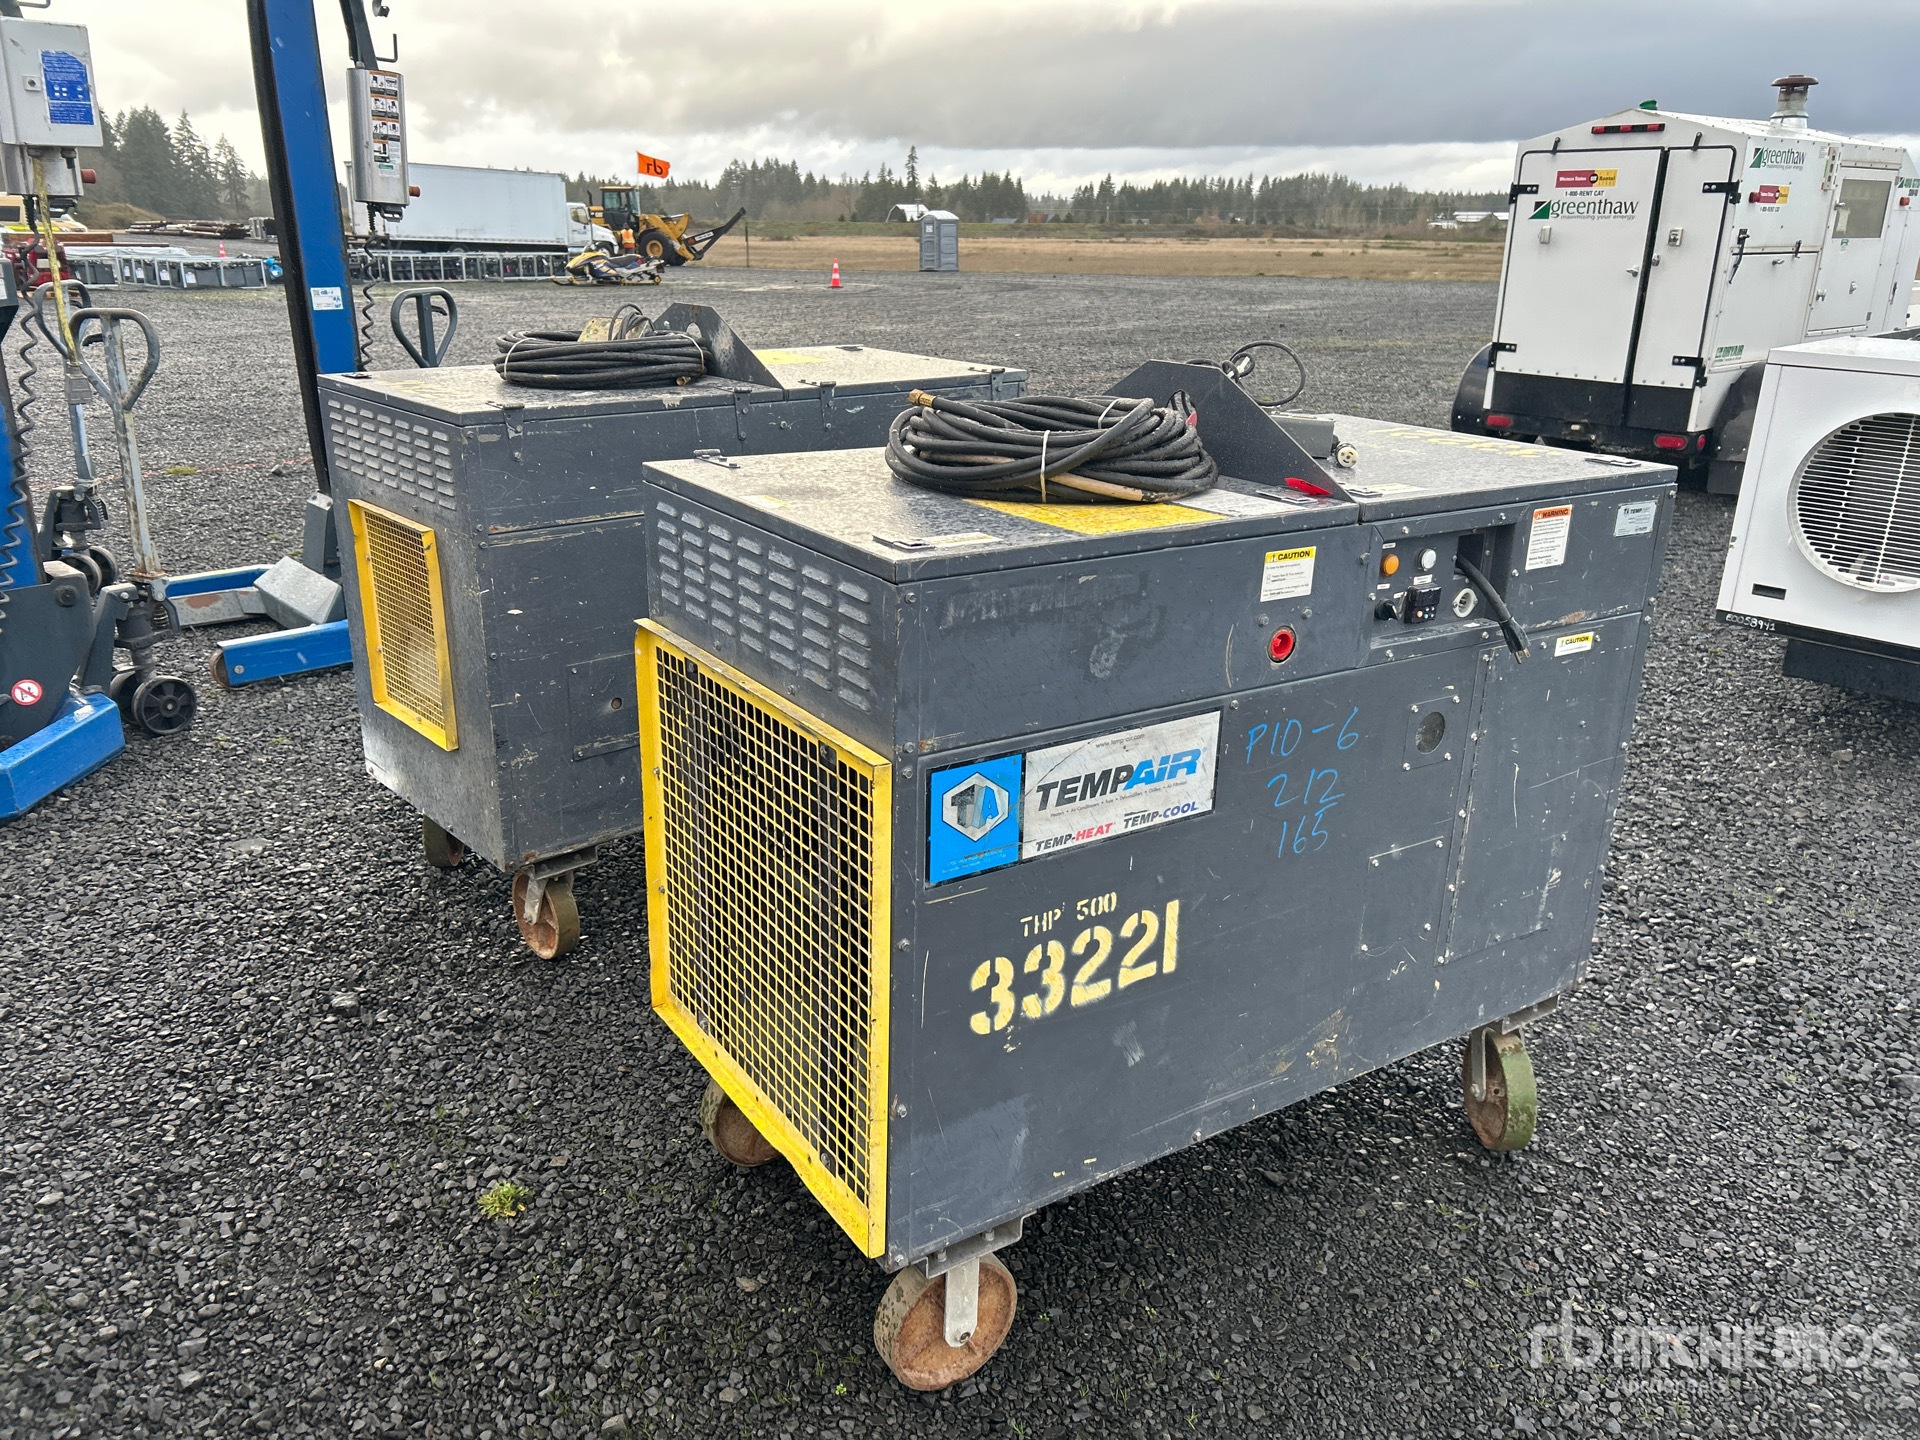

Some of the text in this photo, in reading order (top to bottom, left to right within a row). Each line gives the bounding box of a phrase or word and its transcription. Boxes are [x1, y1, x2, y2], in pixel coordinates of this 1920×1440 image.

[1761, 147, 1807, 168] greenthaw
[1550, 198, 1639, 219] greenthaw
[1542, 508, 1569, 519] WARNING
[1277, 550, 1311, 561] CAUTION
[1564, 635, 1590, 646] CAUTION
[1266, 768, 1345, 808] 212
[1035, 801, 1199, 852] TEMP-HEAT TEMP-COOL
[1277, 801, 1338, 859] 165
[1020, 891, 1118, 937] THP 500
[970, 899, 1180, 1036] 33221
